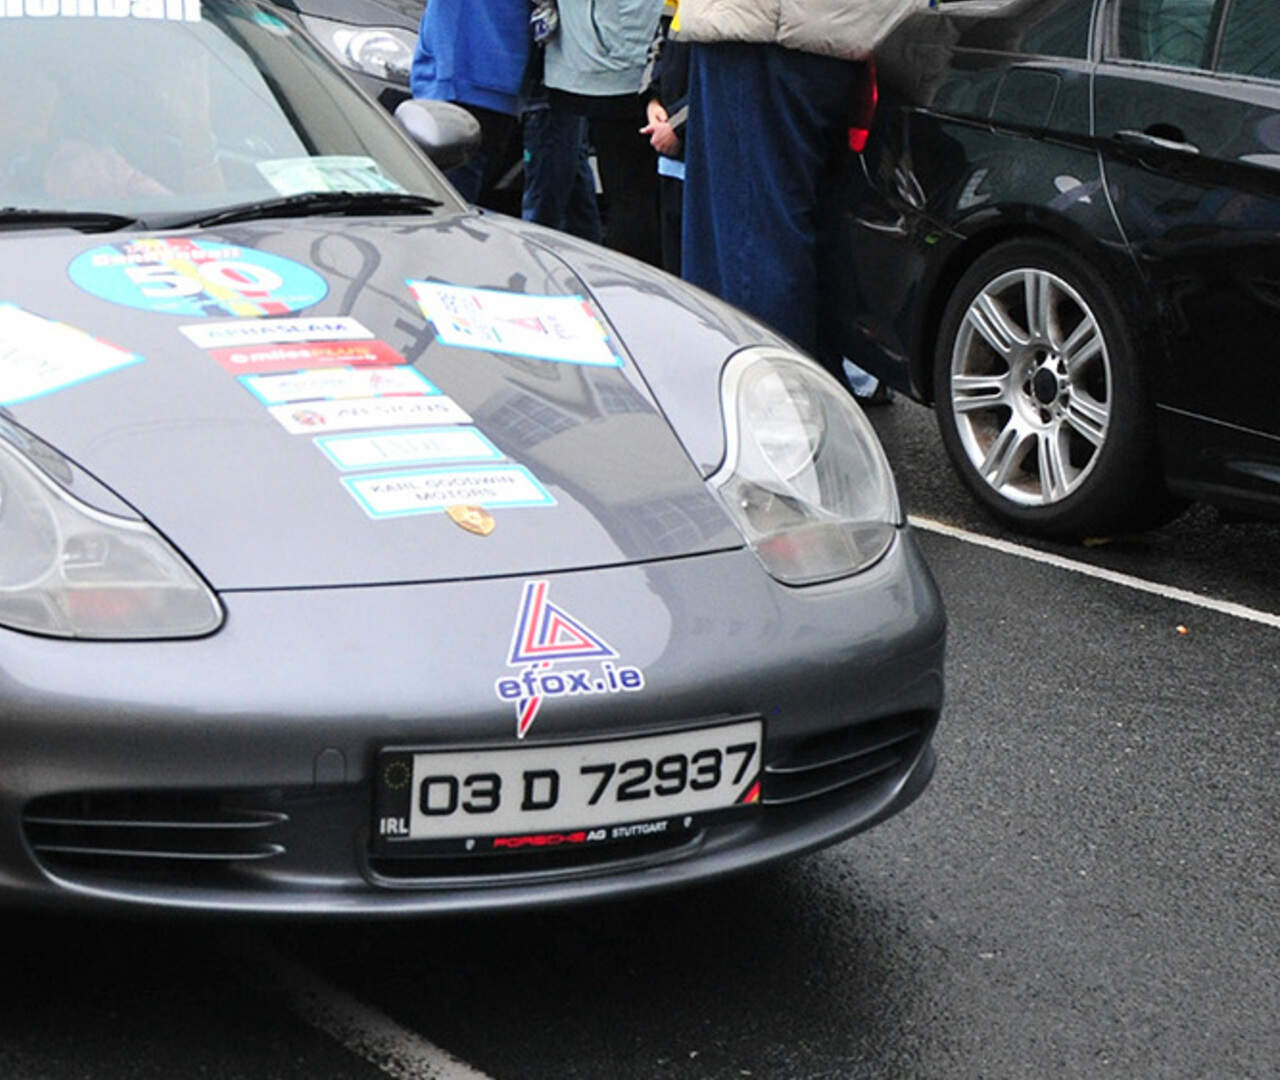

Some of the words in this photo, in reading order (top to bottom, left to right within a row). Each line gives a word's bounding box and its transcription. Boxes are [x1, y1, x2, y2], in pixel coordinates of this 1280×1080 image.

[125, 260, 283, 298] 50
[370, 480, 419, 494] KARL
[416, 488, 496, 502] MOTORS
[496, 663, 643, 700] efox.ie
[419, 772, 501, 817] 03
[521, 769, 559, 811] D
[580, 741, 758, 807] 72937
[380, 817, 409, 835] IRL
[494, 831, 587, 848] PORSCHE
[587, 829, 608, 842] AG
[611, 821, 668, 839] STUTTGART
